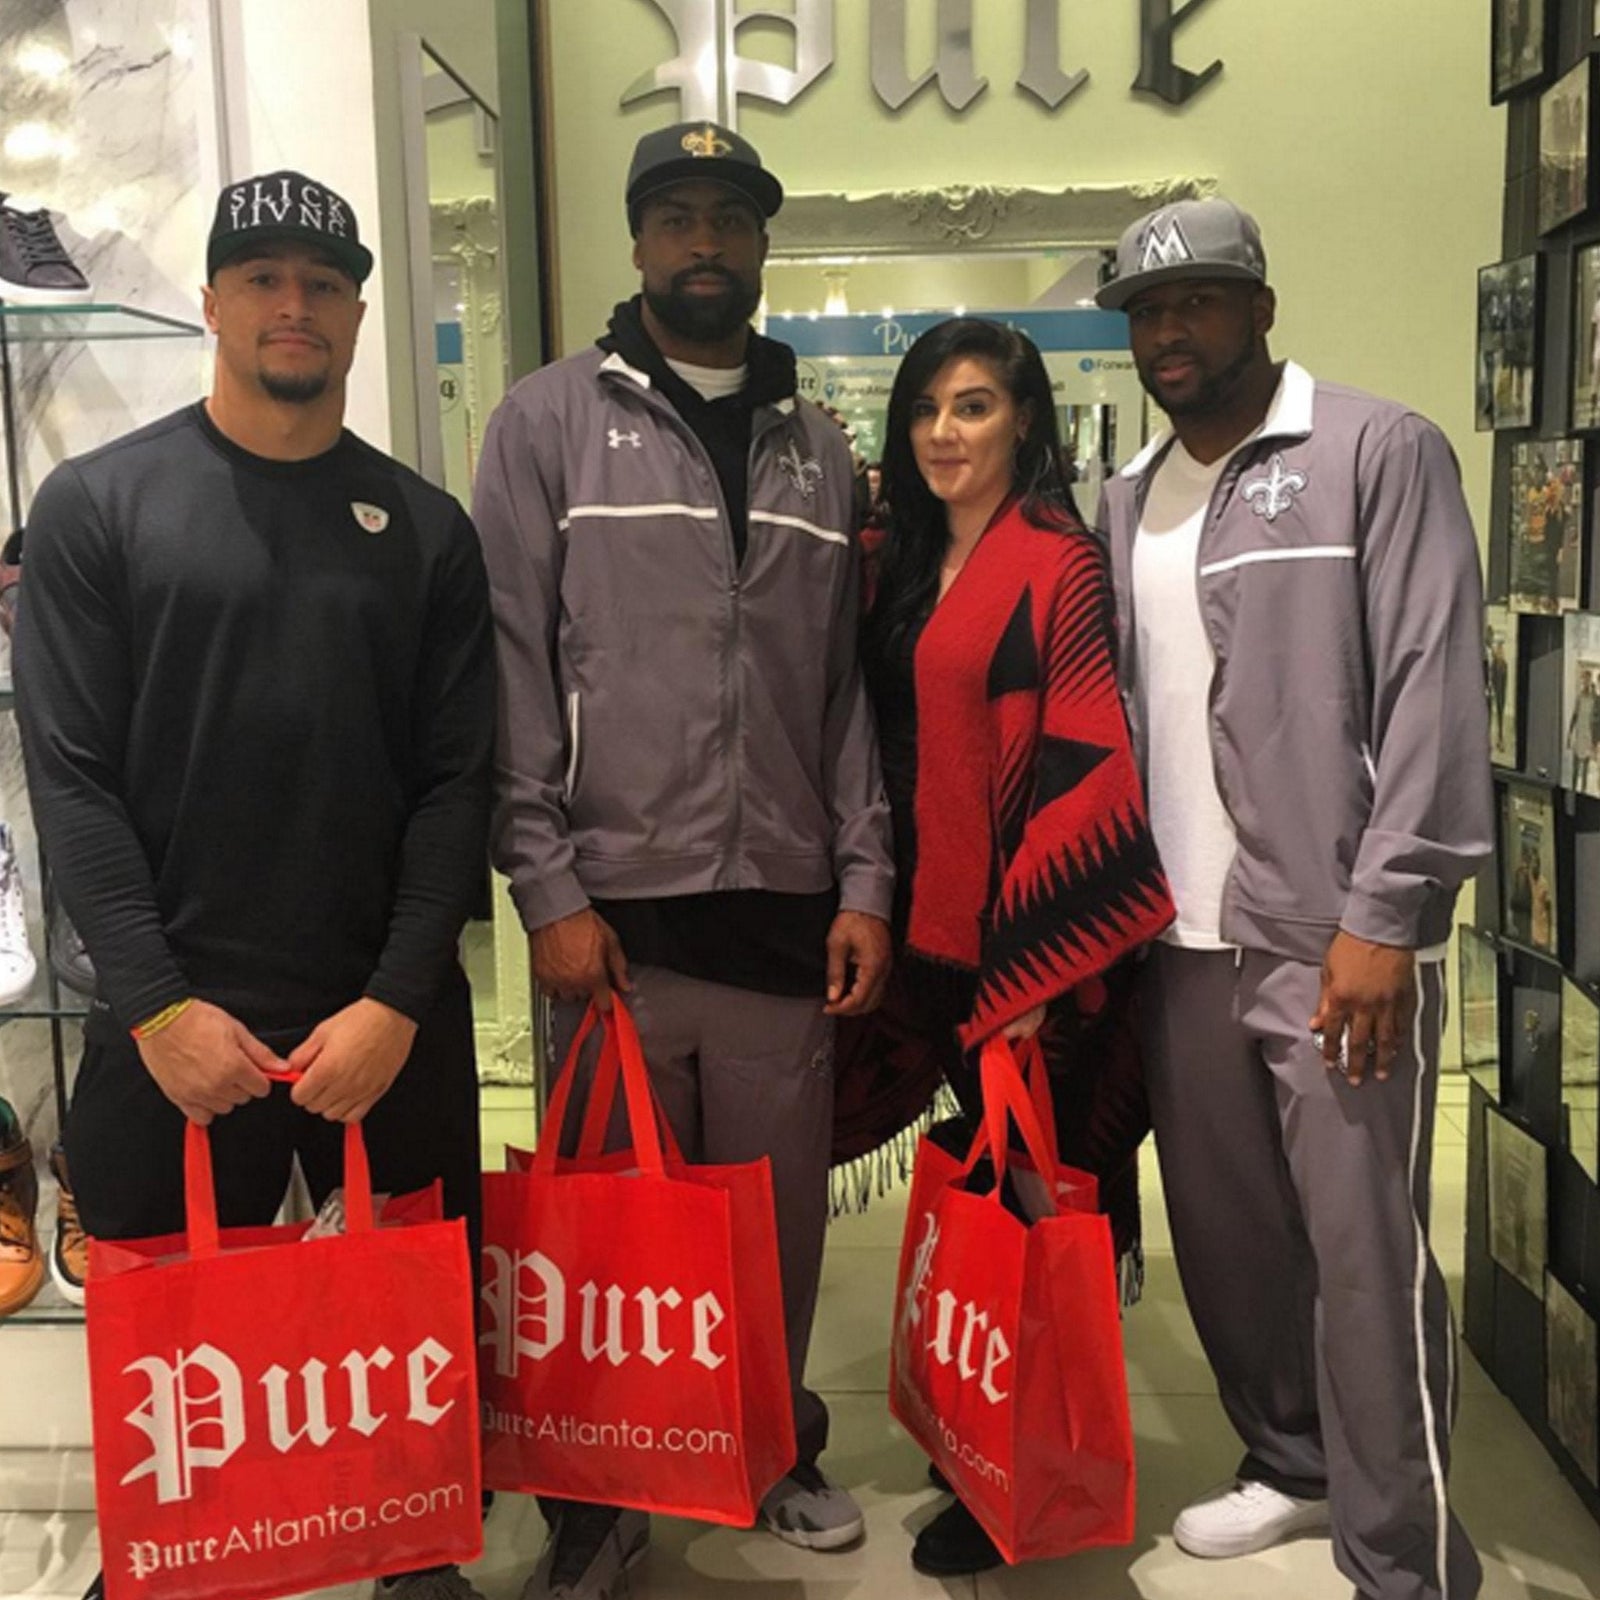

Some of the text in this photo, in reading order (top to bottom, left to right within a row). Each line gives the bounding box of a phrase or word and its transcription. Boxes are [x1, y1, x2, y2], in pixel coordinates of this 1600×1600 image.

[1139, 213, 1196, 273] M
[479, 1245, 727, 1378] Pure
[120, 1336, 455, 1505] Pure
[127, 1483, 463, 1580] PureAtlanta.com
